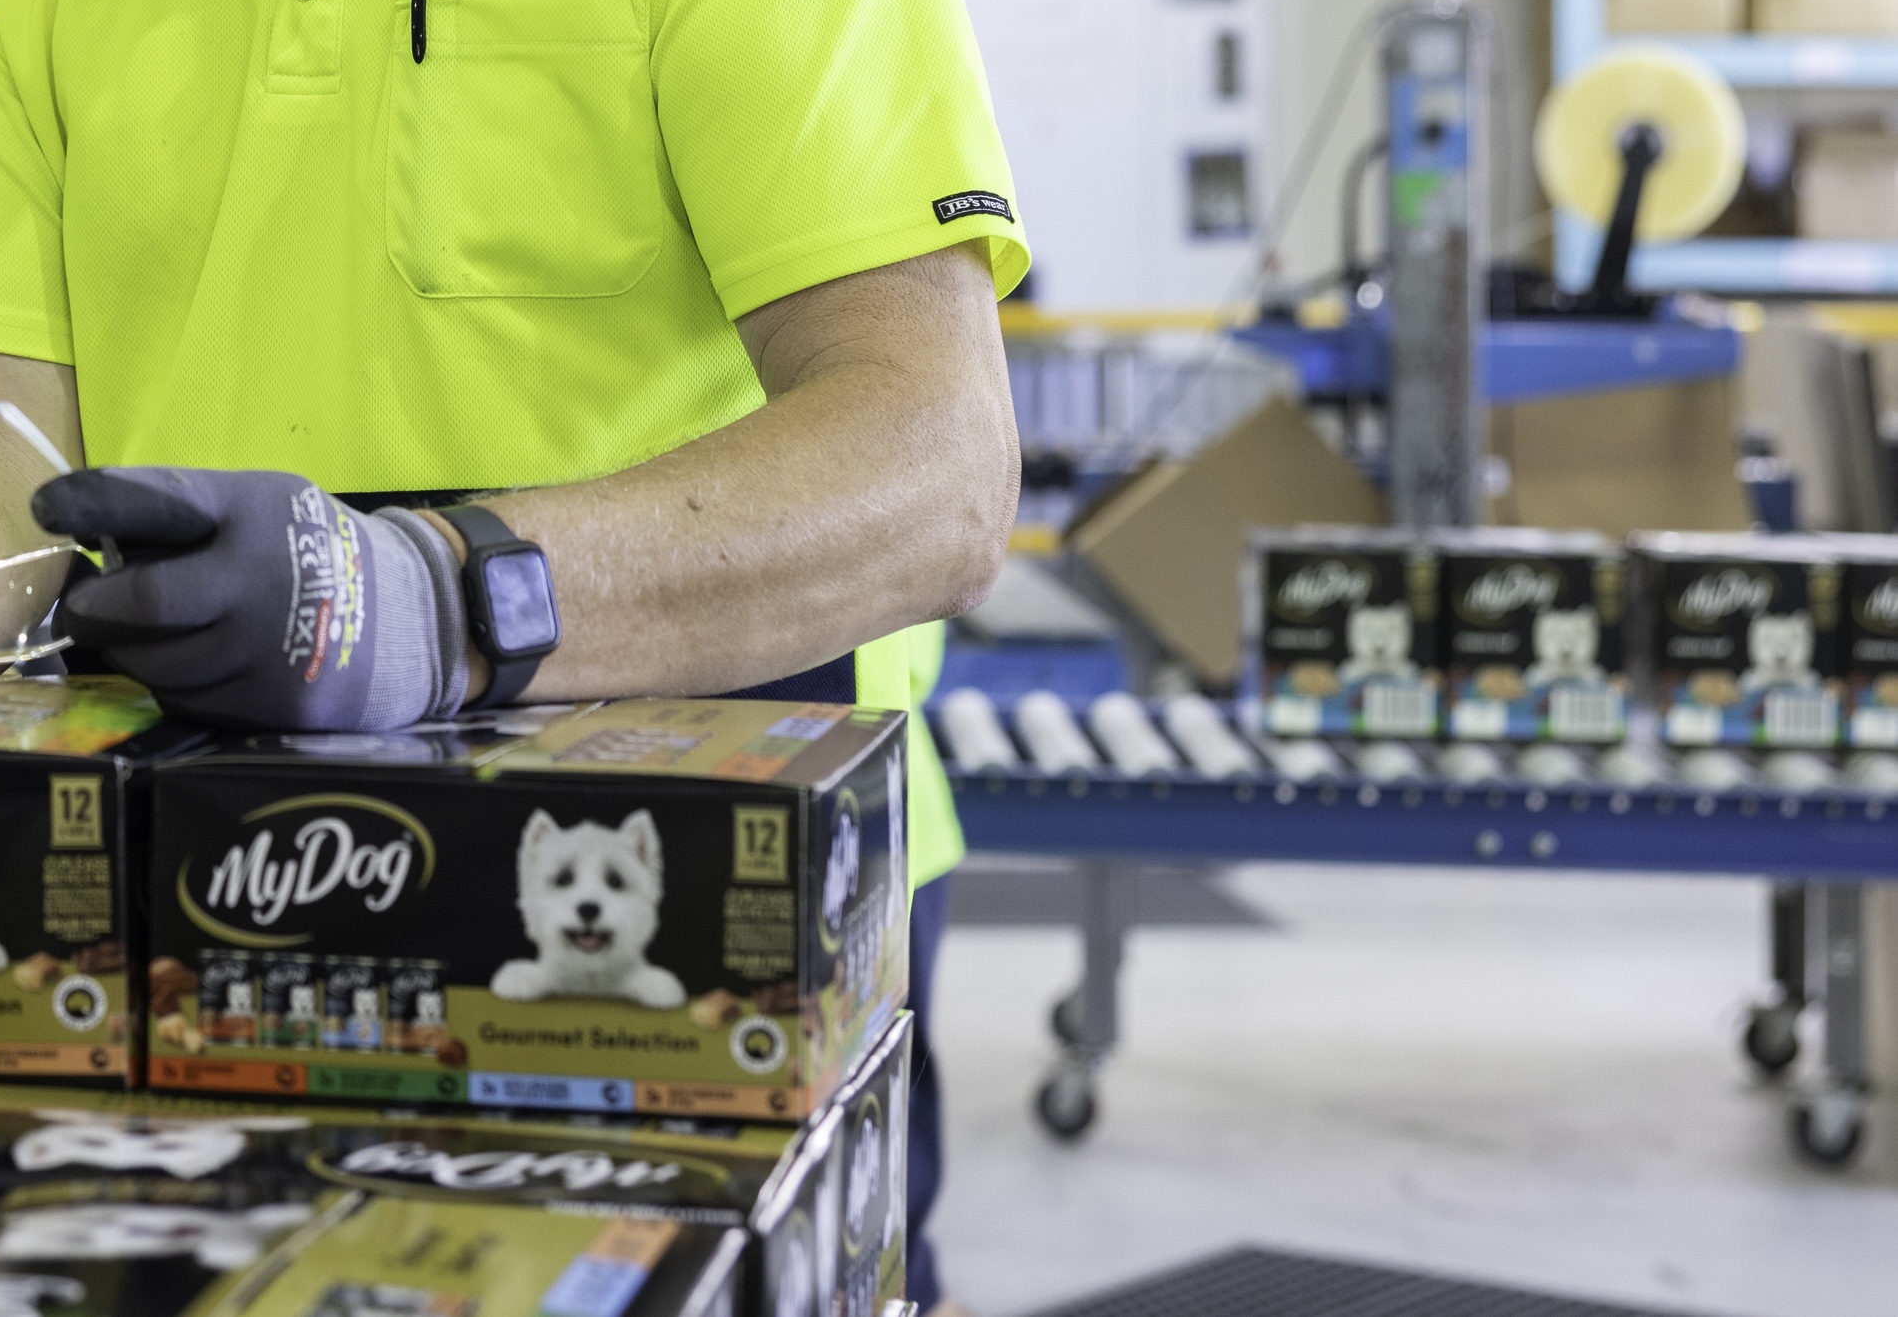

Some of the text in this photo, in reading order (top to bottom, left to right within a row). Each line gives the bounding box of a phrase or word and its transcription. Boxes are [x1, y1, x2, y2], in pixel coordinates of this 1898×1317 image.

[944, 197, 980, 215] JB's
[59, 787, 93, 823] 12
[745, 818, 778, 856] 12
[207, 816, 412, 926] MyDog
[478, 1020, 701, 1053] Gourmet Selection
